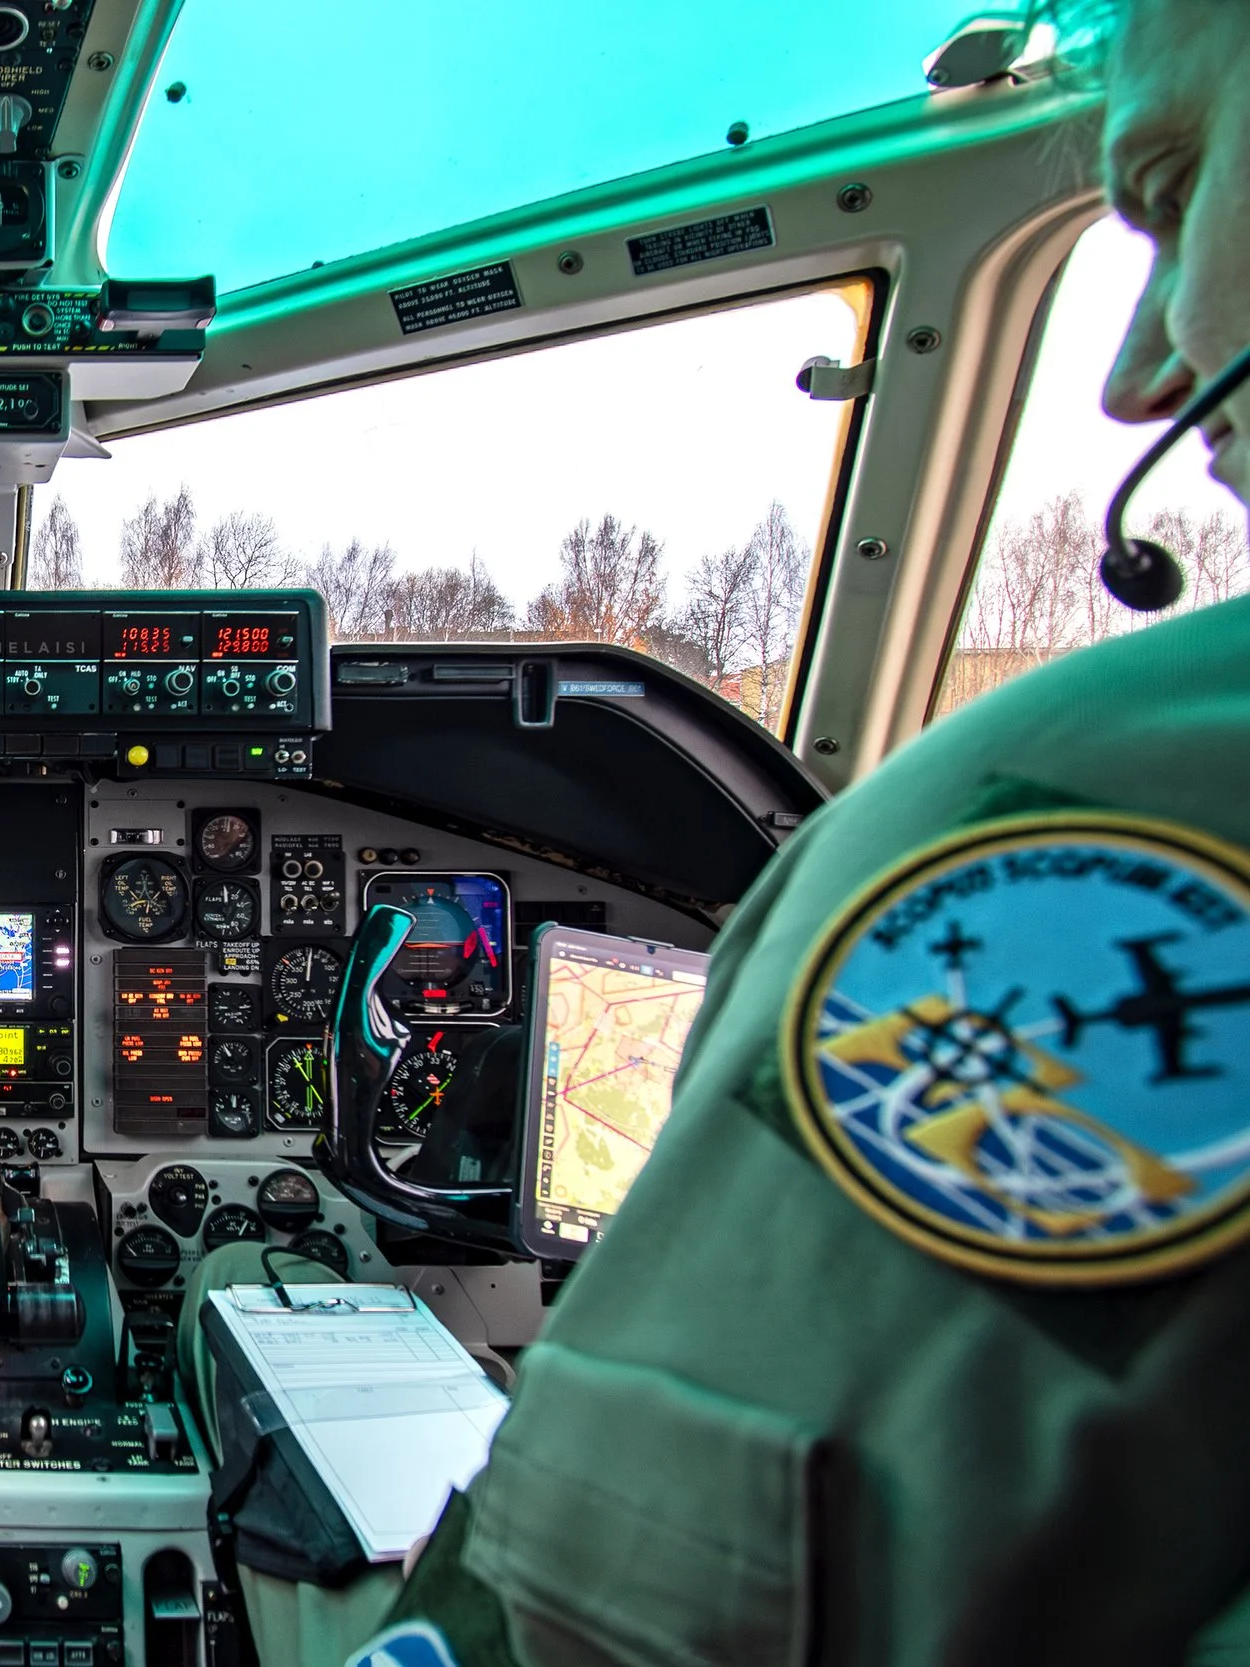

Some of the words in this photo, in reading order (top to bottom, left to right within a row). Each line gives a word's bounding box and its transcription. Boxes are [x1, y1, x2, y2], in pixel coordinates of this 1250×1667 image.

[123, 627, 170, 640] 108.35
[218, 628, 269, 640] 121.500
[196, 941, 218, 949] FLAPS
[23, 1460, 81, 1470] SWITCHES
